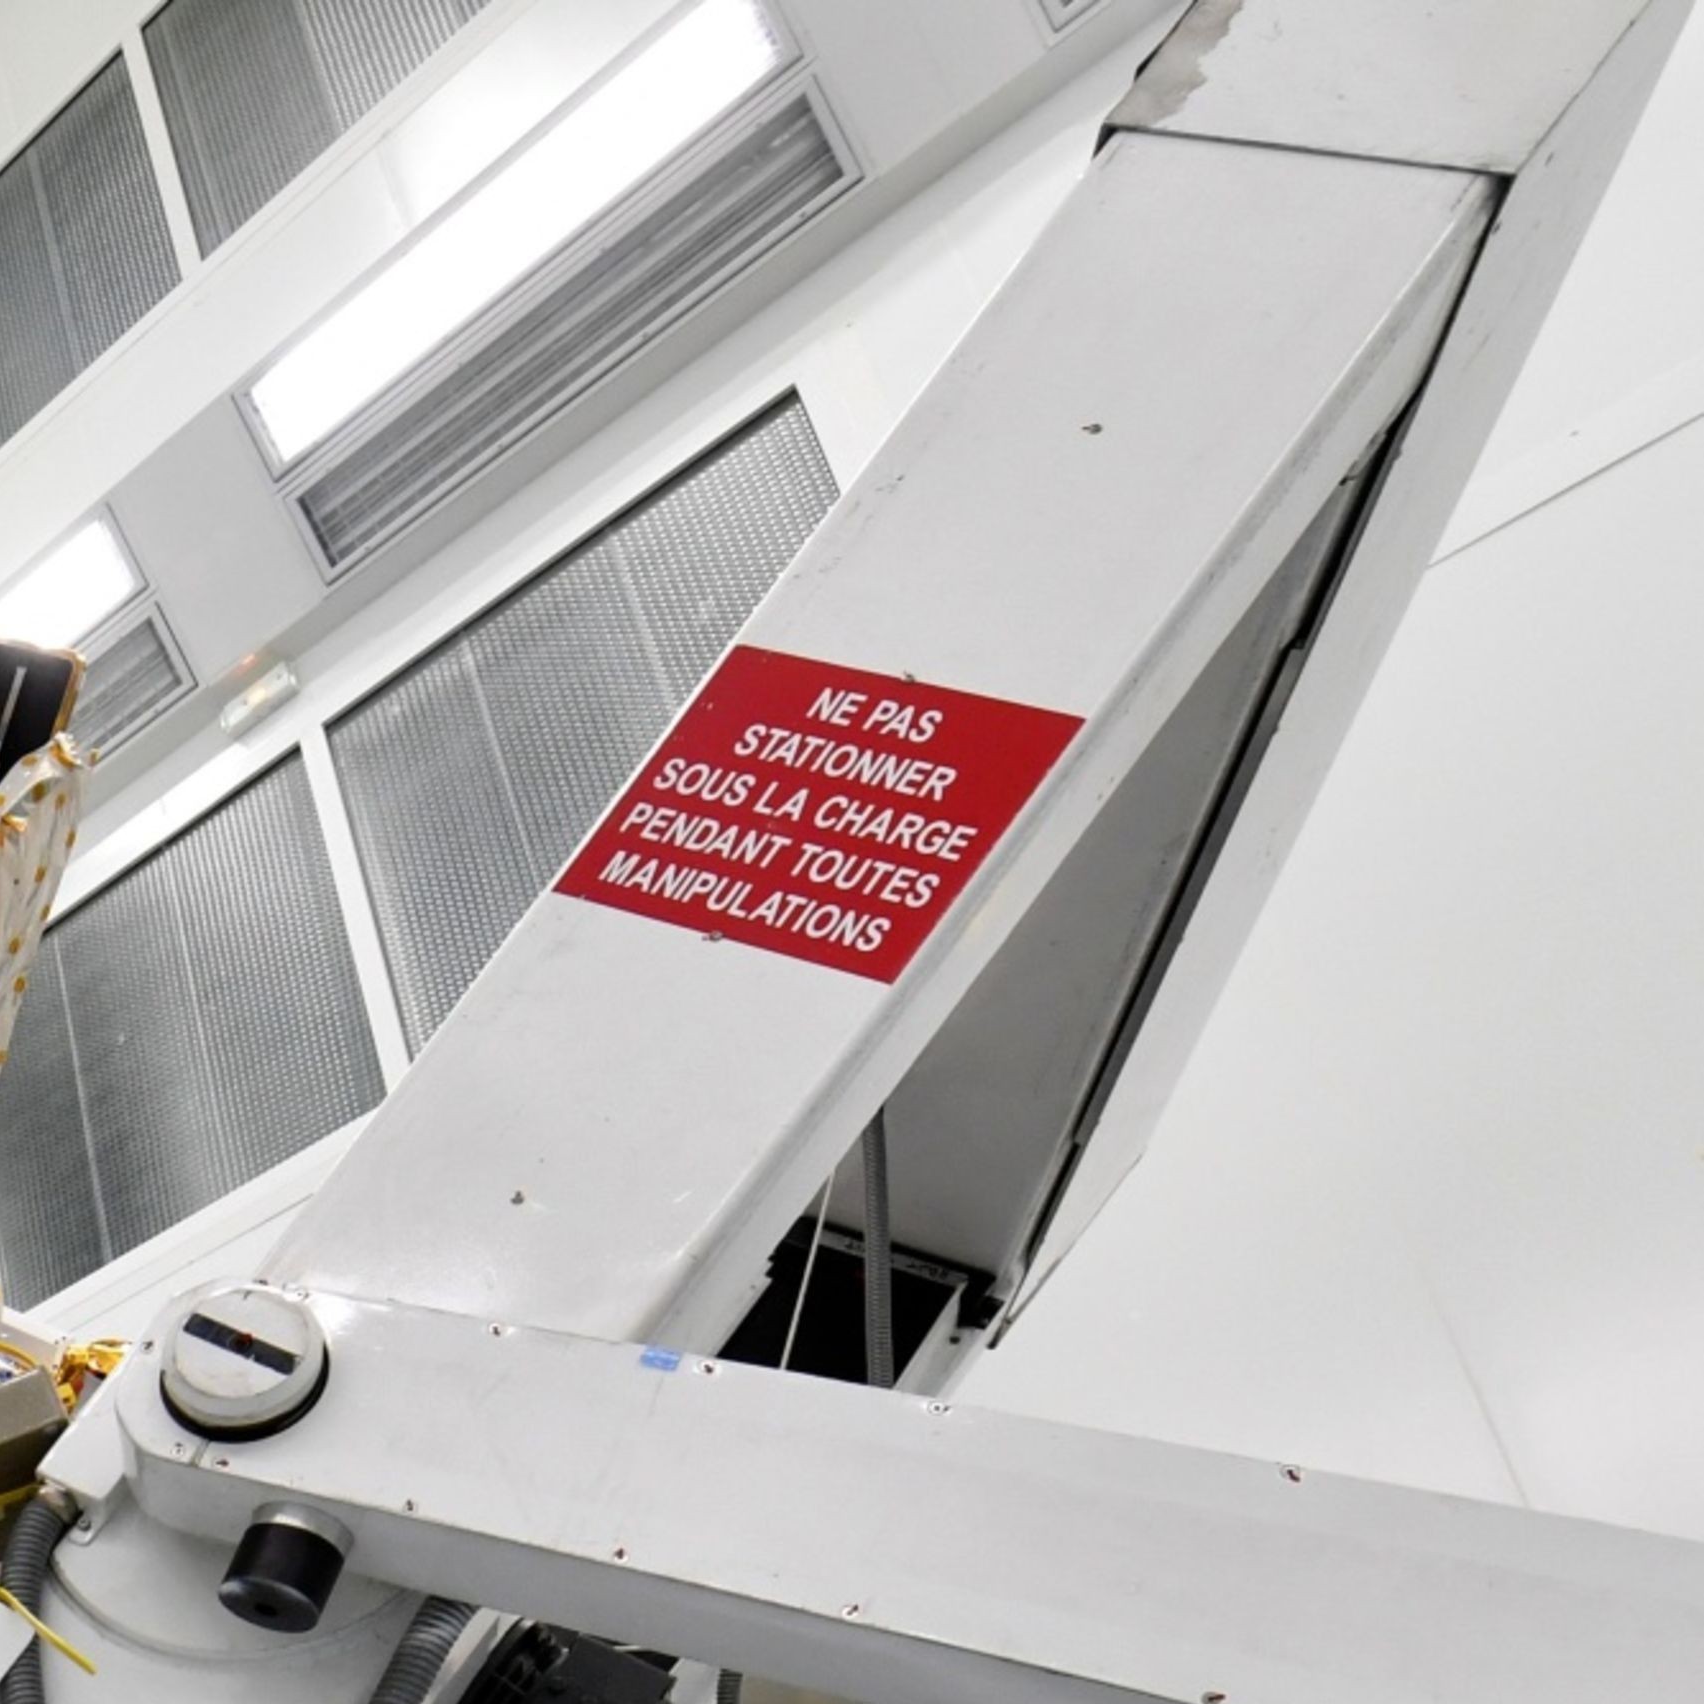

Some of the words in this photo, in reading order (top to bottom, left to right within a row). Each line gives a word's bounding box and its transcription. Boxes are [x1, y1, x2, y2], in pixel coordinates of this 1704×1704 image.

[734, 724, 957, 801] STATIONNER
[807, 687, 866, 727] NE
[862, 700, 943, 743] PAS
[620, 802, 790, 865] PENDANT
[791, 845, 940, 910] TOUTES
[654, 758, 756, 807] SOUS
[754, 781, 808, 819] LA
[815, 796, 978, 862] CHARGE
[598, 851, 891, 953] MANIPULATIONS
